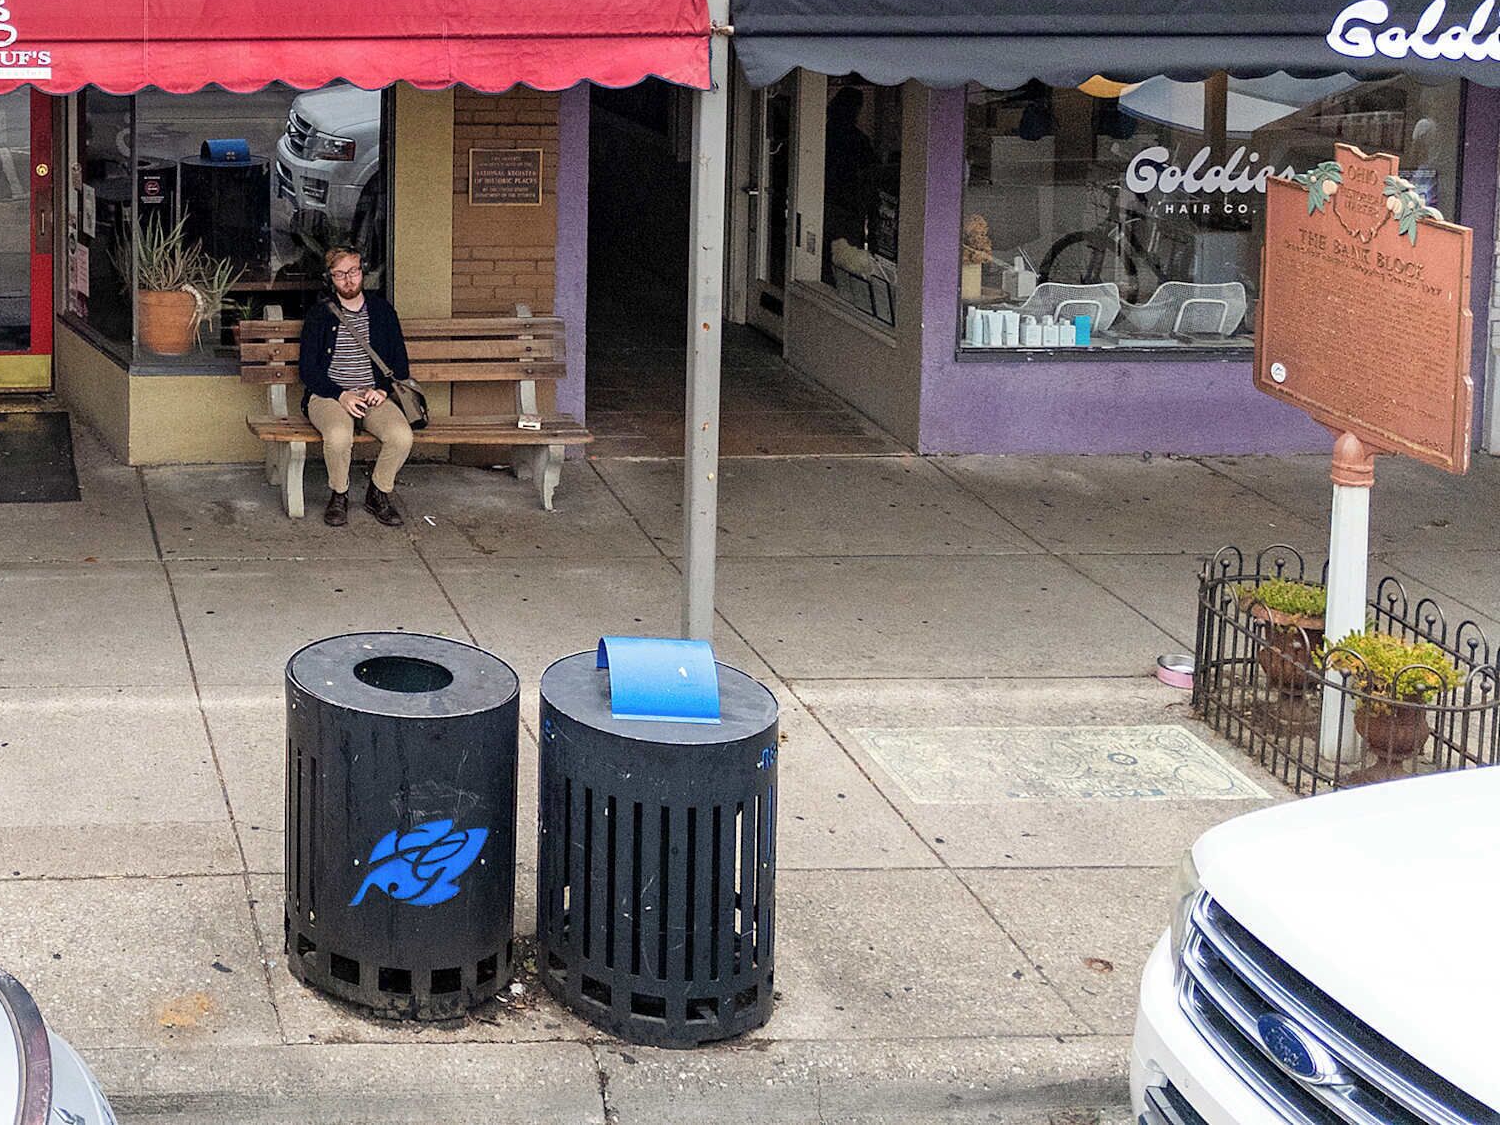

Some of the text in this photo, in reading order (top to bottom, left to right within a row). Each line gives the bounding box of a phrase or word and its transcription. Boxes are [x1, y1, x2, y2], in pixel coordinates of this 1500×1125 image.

[1165, 203, 1257, 215] HAIR CO.
[1299, 228, 1328, 251] THE
